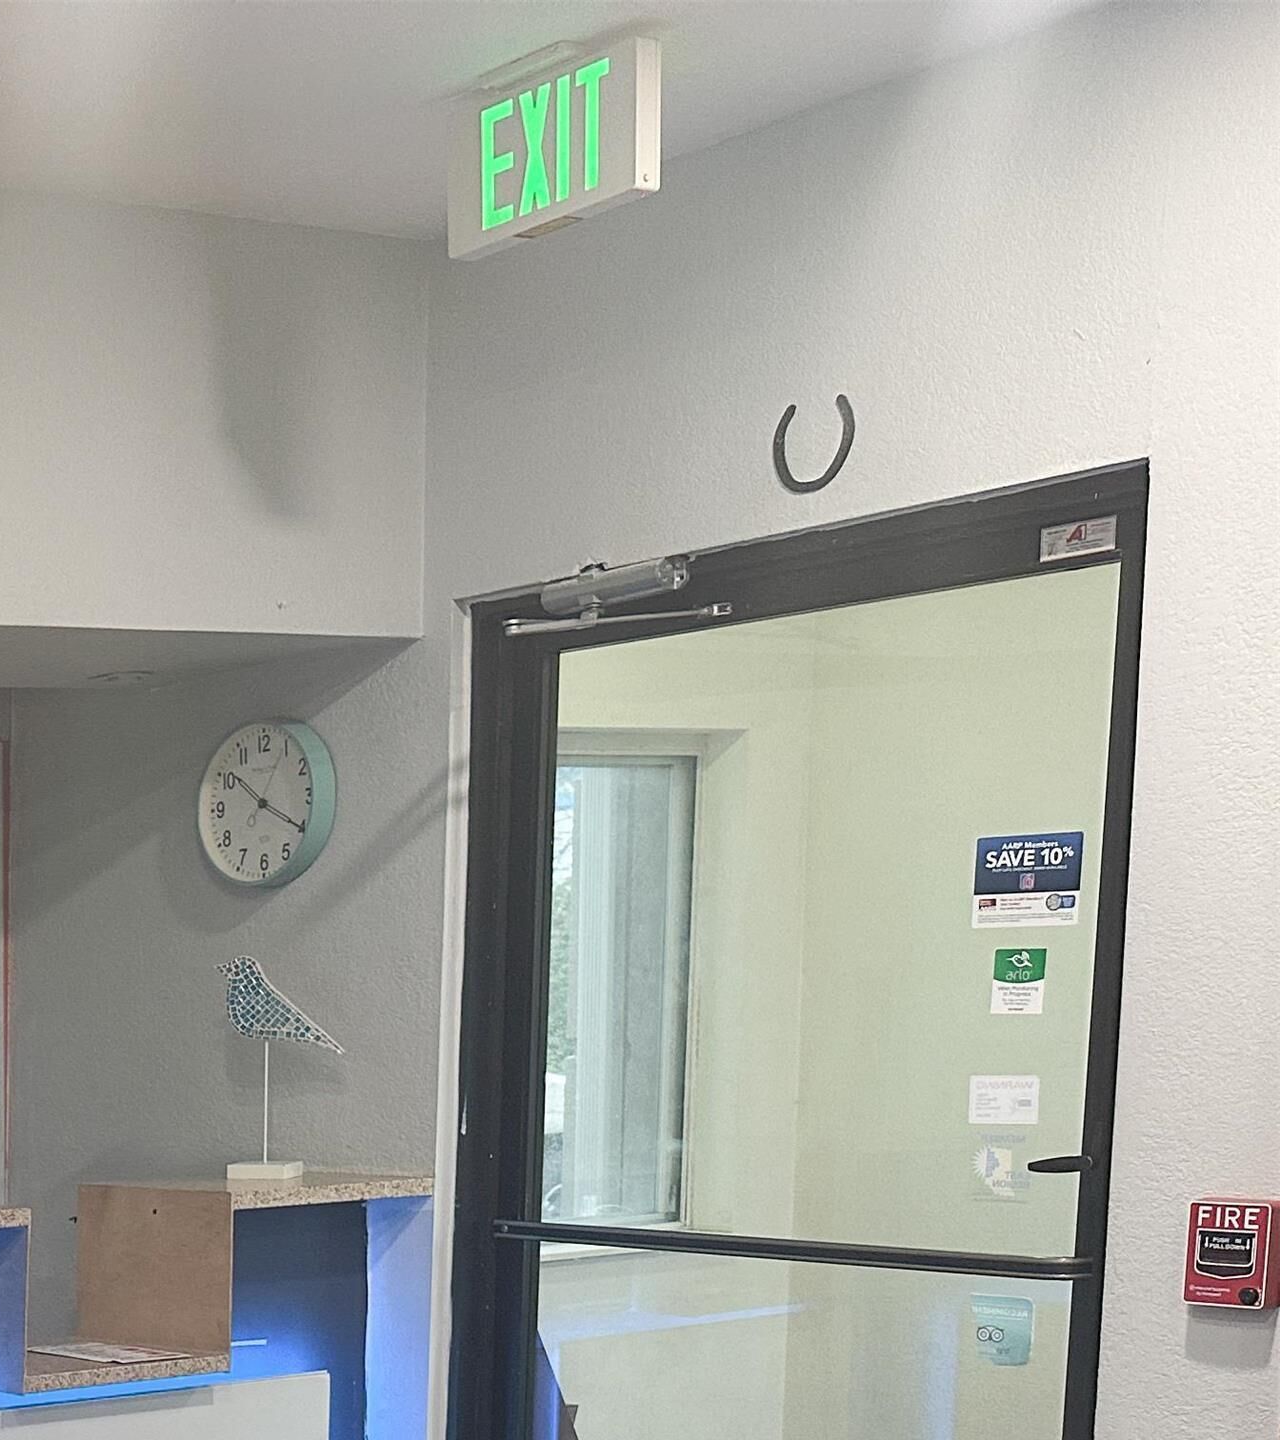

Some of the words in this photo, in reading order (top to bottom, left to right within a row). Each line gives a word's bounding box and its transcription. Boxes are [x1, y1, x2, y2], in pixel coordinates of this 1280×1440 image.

[481, 57, 610, 231] EXIT
[258, 735, 271, 753] 12
[284, 739, 288, 757] 1
[240, 747, 248, 765] 11
[298, 758, 307, 776] 2
[223, 772, 235, 790] 10
[305, 787, 312, 805] 3
[216, 801, 224, 818] 9
[223, 830, 231, 847] 8
[1024, 840, 1059, 848] Members
[239, 848, 248, 866] 7
[281, 843, 290, 861] 5
[985, 849, 1036, 868] SAVE
[1040, 846, 1075, 866] 10%
[260, 853, 269, 871] 6
[1005, 969, 1031, 981] arlo
[1198, 1205, 1260, 1229] FIRE
